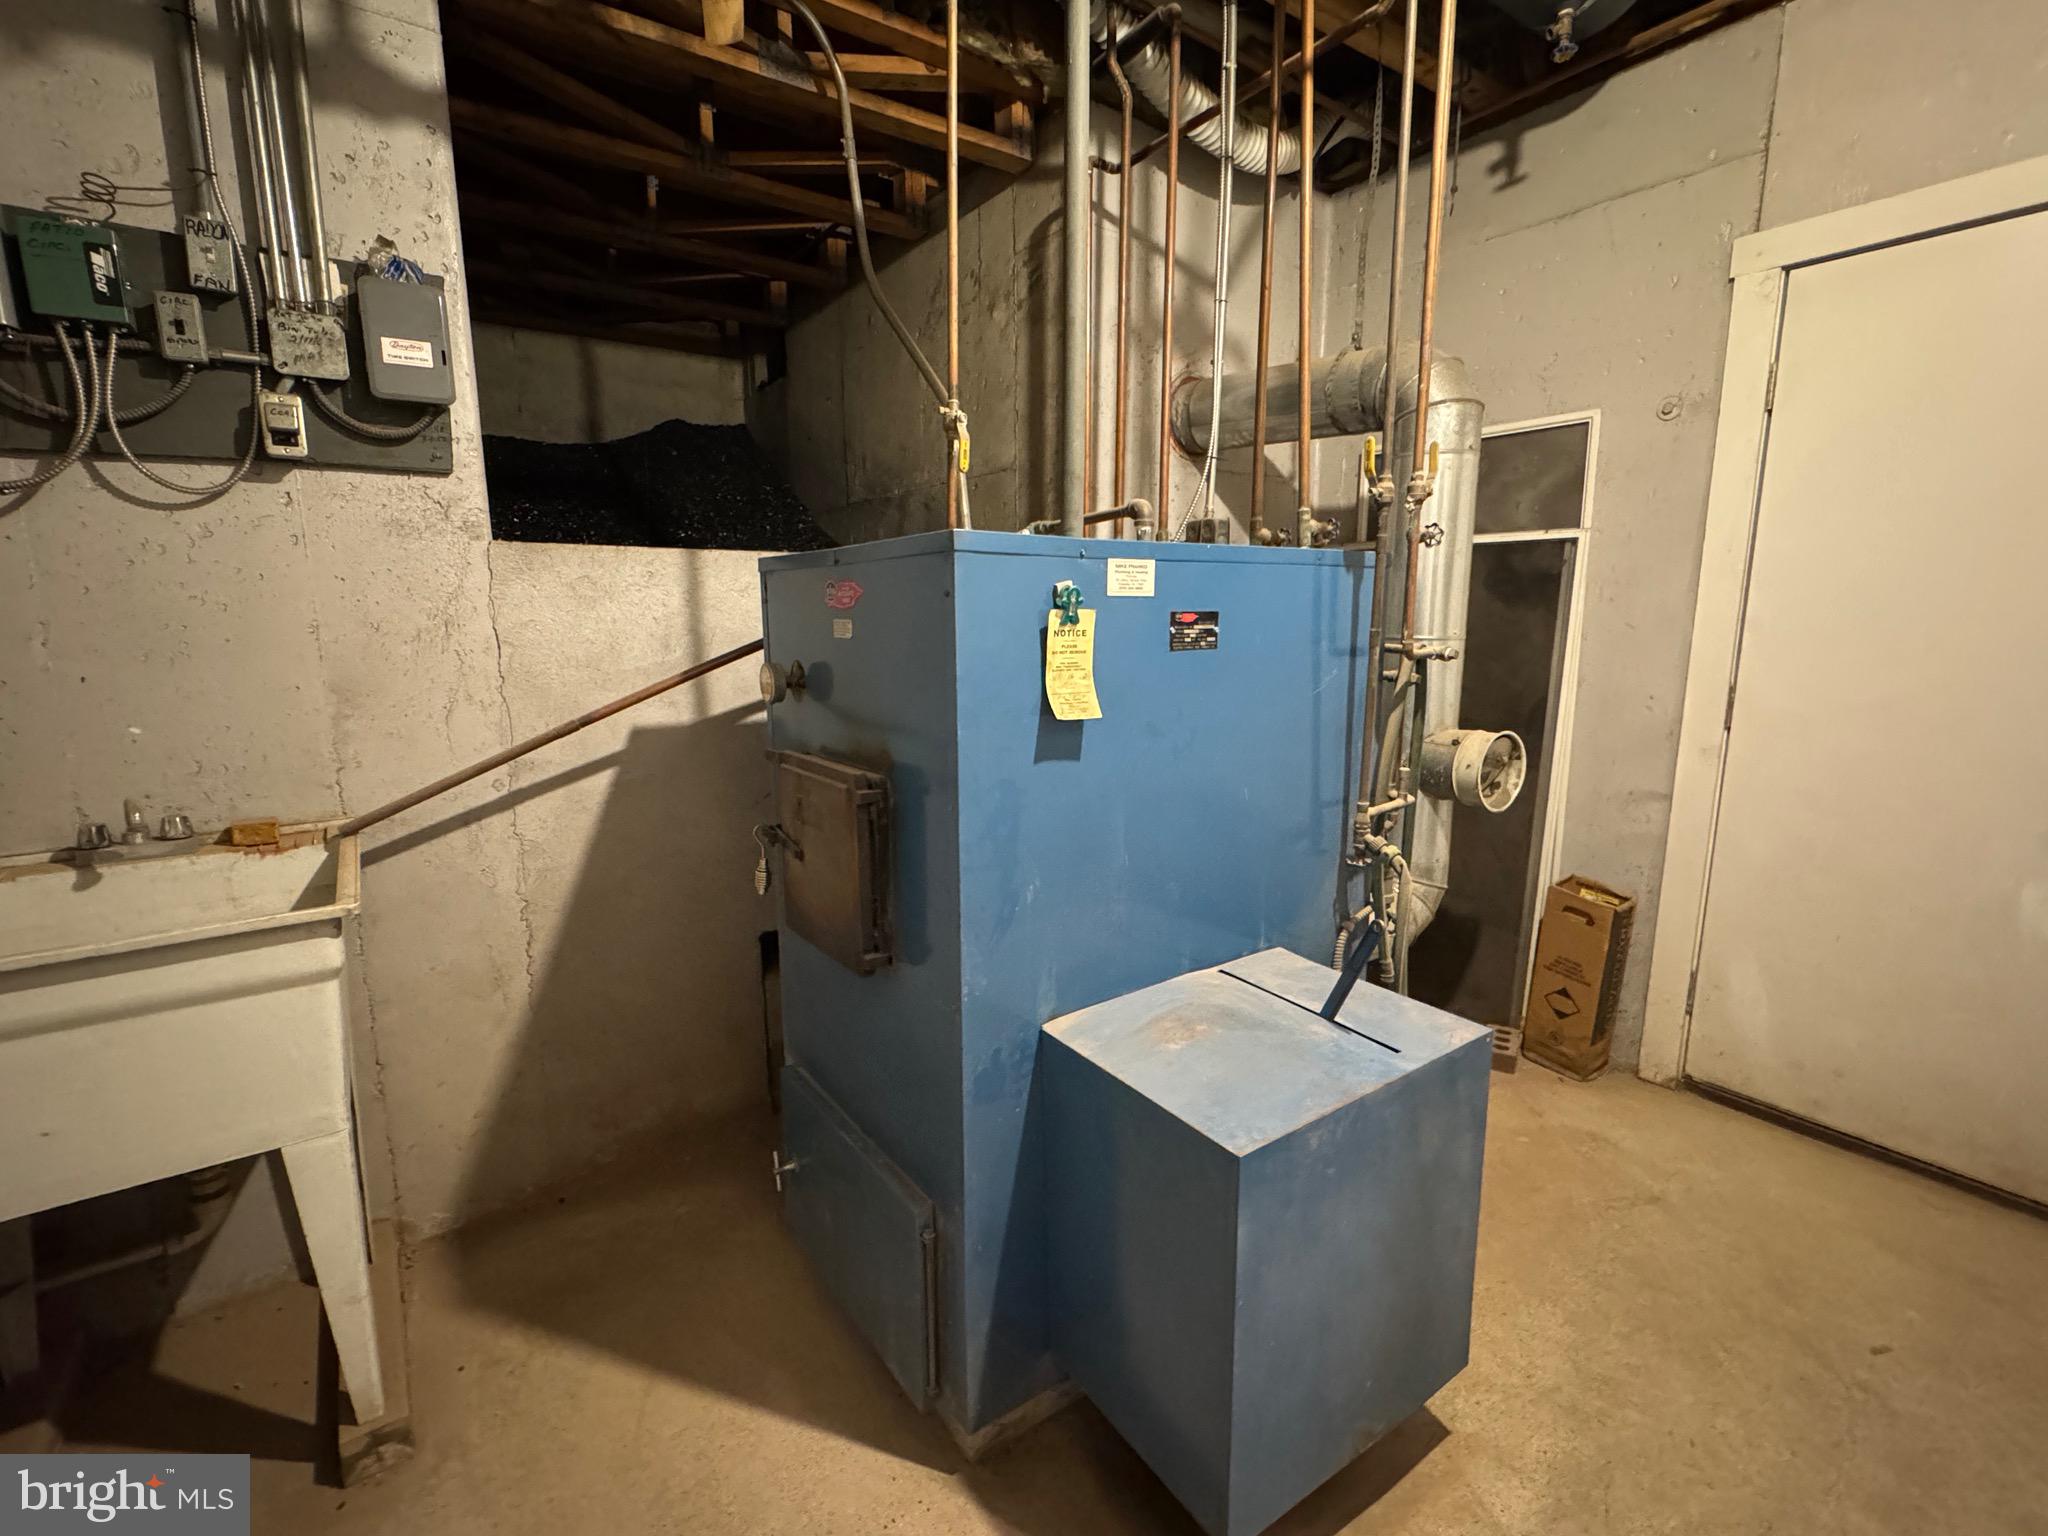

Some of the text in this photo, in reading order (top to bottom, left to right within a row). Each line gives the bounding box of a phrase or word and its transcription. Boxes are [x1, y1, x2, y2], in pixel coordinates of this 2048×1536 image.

[184, 217, 231, 242] RADON
[89, 247, 116, 294] Taco
[193, 273, 231, 292] FAN
[391, 340, 423, 352] Dayton
[1053, 628, 1087, 638] NOTICE
